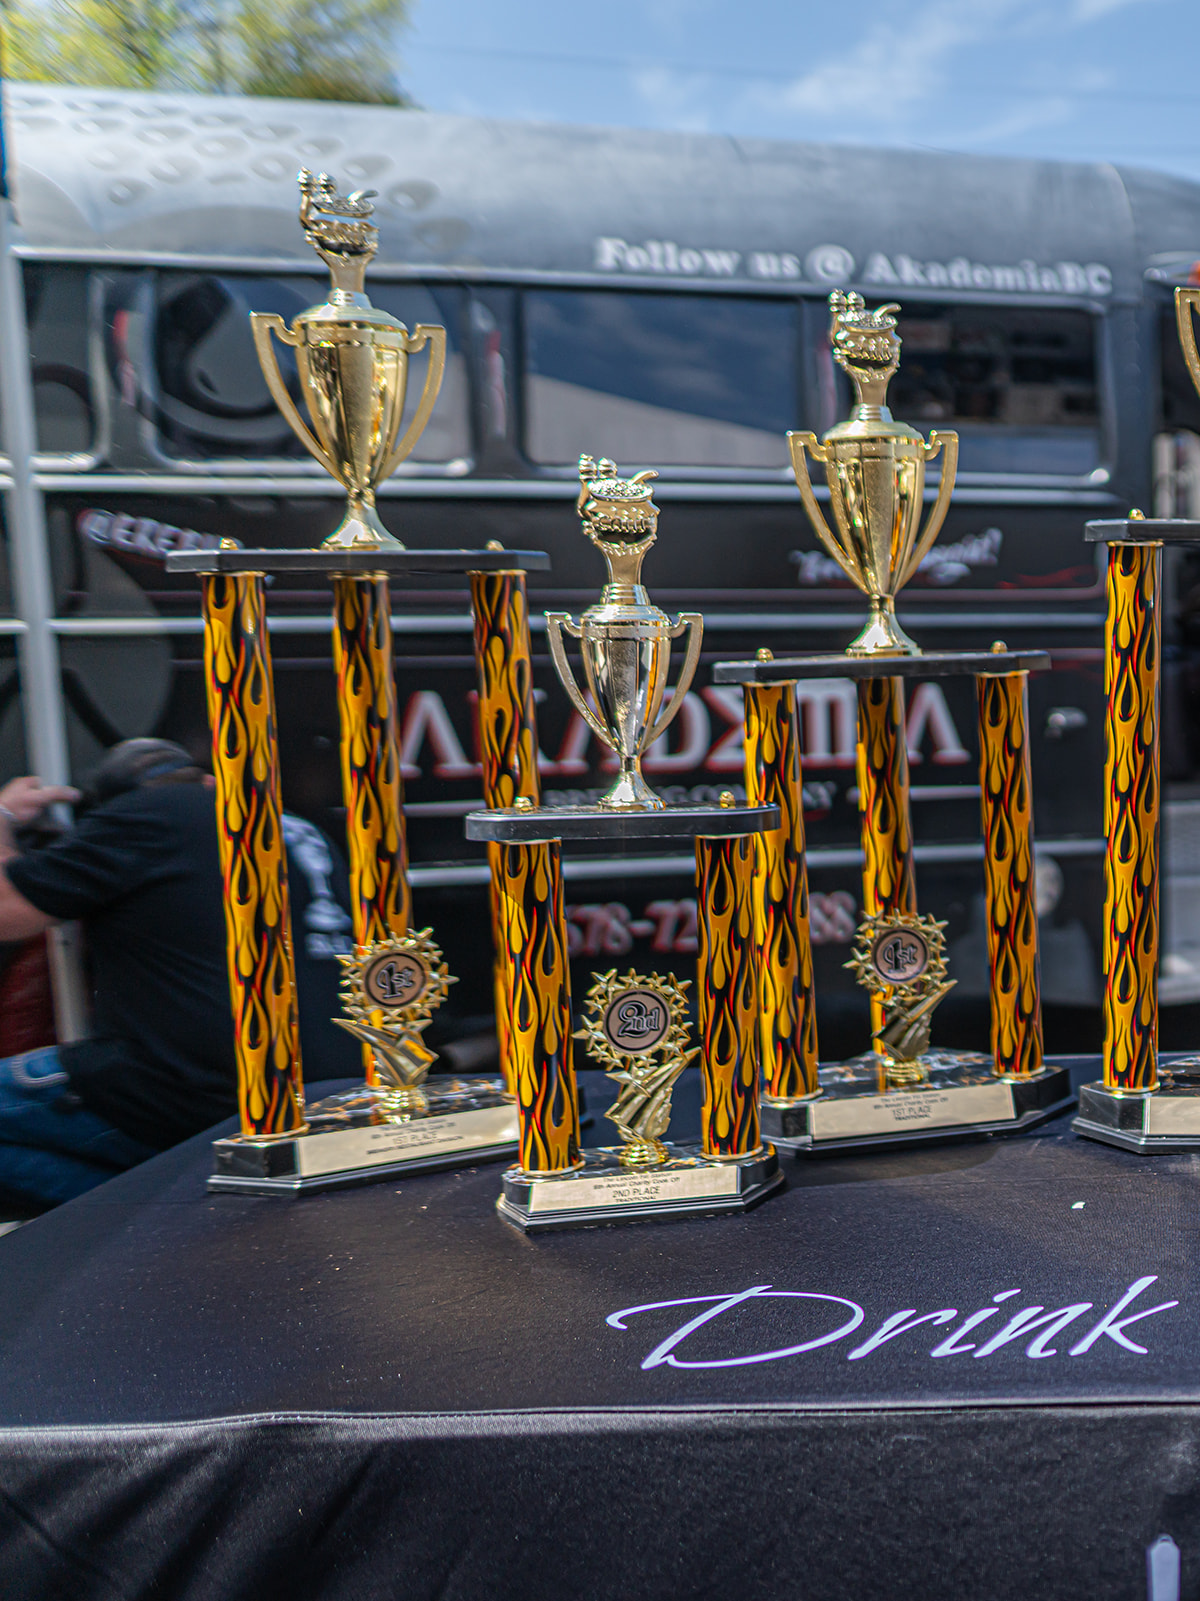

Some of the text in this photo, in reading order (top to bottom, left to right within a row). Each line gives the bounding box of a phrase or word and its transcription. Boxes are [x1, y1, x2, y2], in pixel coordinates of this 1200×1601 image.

[597, 237, 1113, 295] Follow us @ AkademiaBC
[883, 937, 918, 974] 1st
[617, 1000, 660, 1038] 2nd
[892, 1105, 932, 1117] 1ST PLACE
[612, 1186, 660, 1198] 2ND PLACE
[605, 1274, 1177, 1371] Drink
